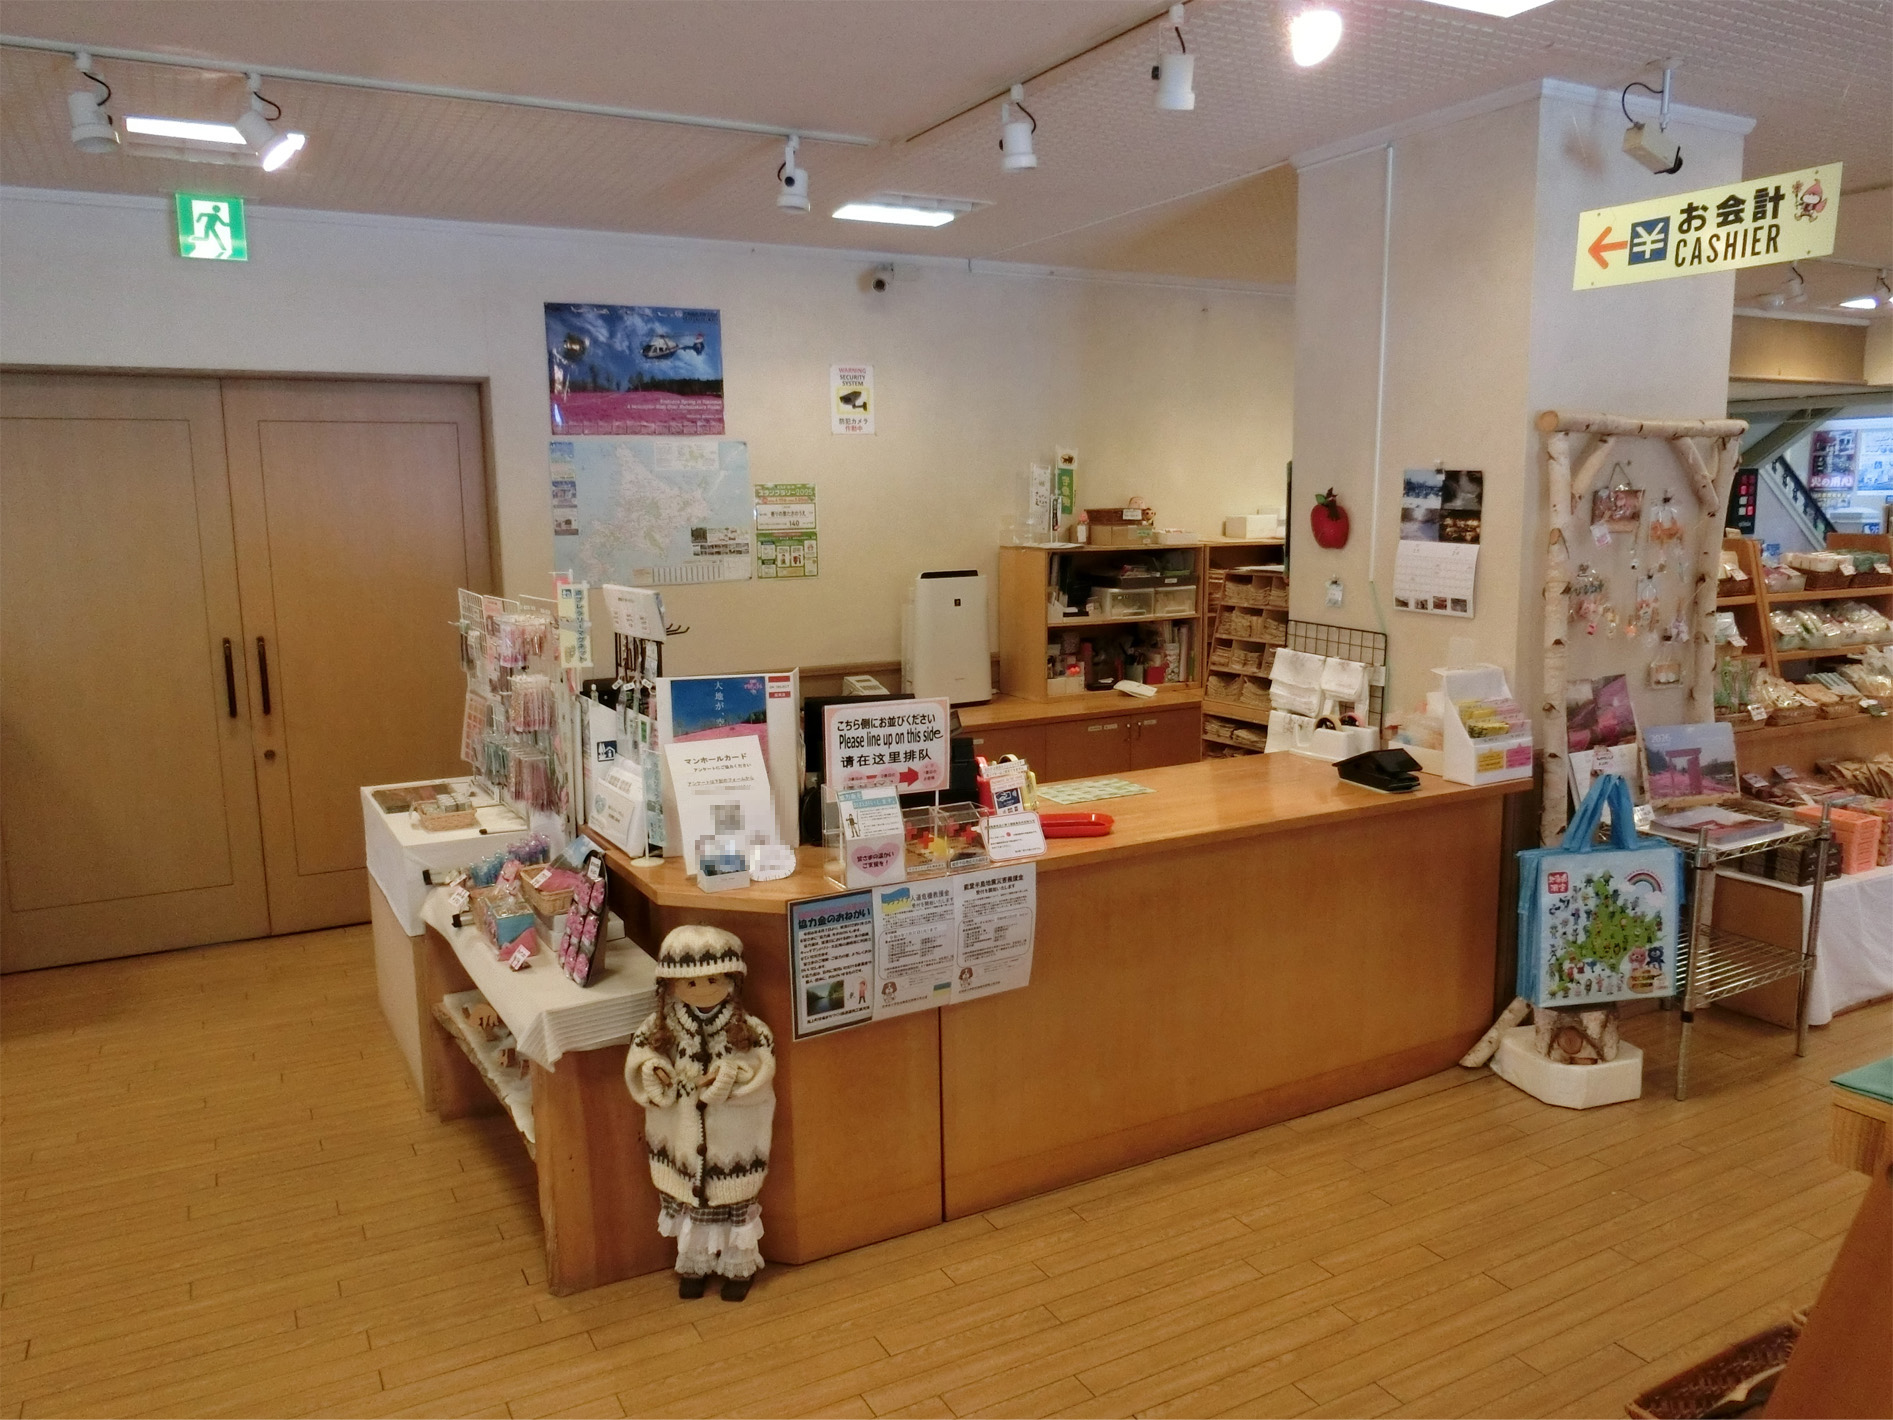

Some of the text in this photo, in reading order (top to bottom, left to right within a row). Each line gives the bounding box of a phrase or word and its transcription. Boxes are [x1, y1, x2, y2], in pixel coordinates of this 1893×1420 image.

[1678, 185, 1786, 234] お会計
[1675, 224, 1781, 268] CASHIER
[1810, 476, 1854, 487] 火の用心
[837, 713, 936, 732] こちら側にお並びください
[838, 726, 944, 750] Please line up on this side
[684, 752, 747, 765] マンホールカード
[840, 748, 932, 768] 请在这里排队
[798, 907, 871, 929] 協力金のおねがい
